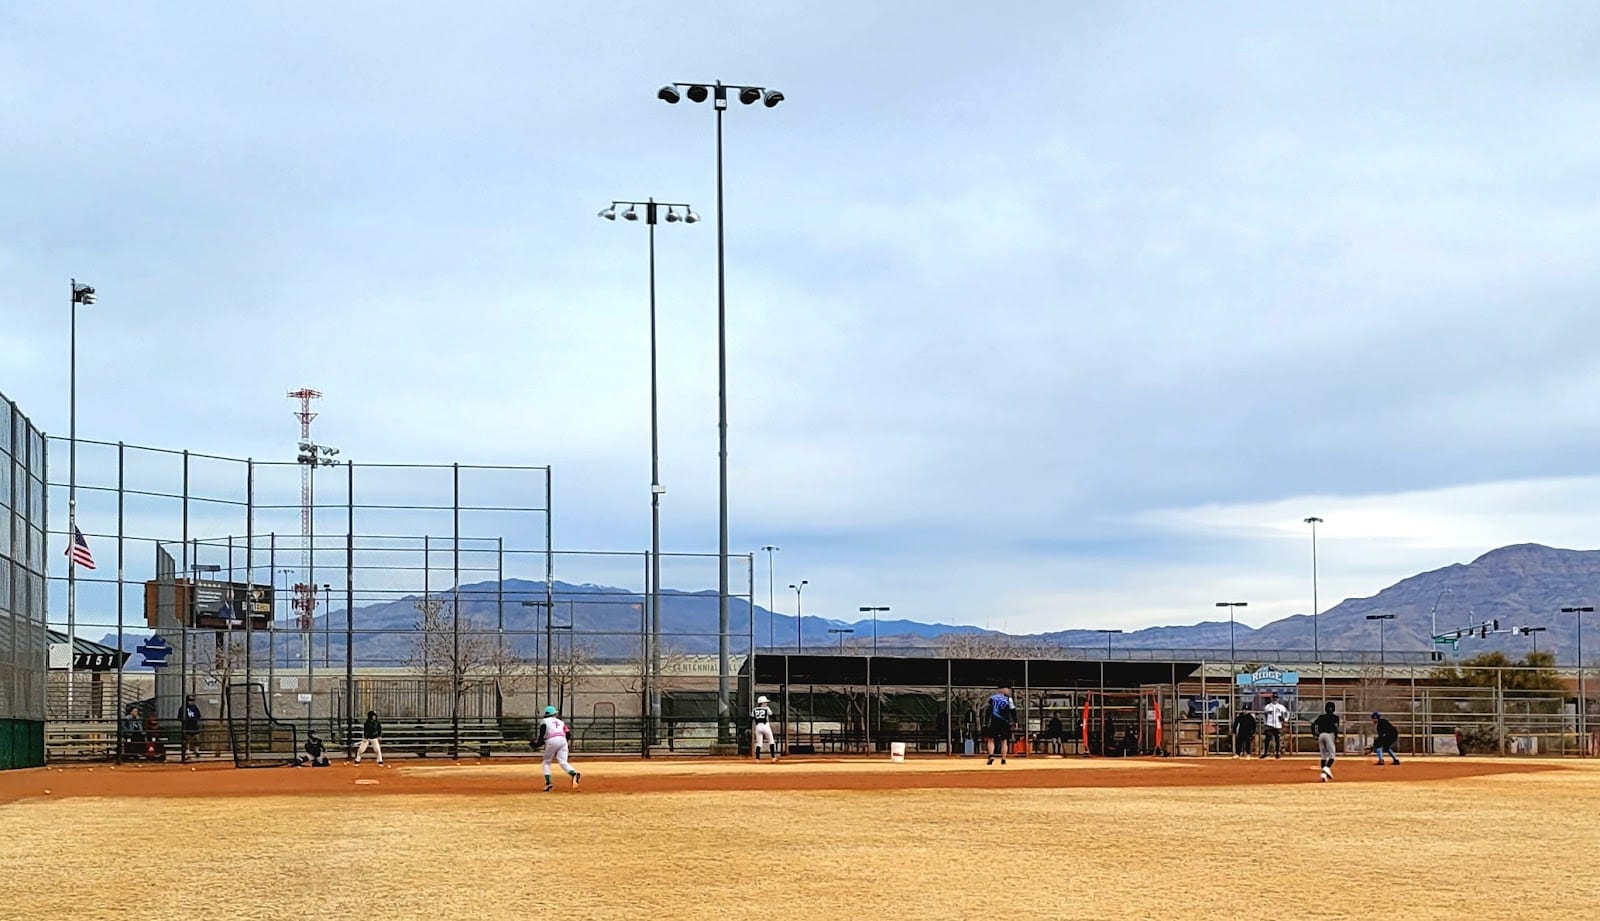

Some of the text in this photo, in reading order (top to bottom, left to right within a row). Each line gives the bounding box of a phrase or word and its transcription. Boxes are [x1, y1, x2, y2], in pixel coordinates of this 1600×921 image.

[74, 654, 113, 667] 7151
[1252, 670, 1282, 682] RIDGE
[754, 709, 766, 719] 22
